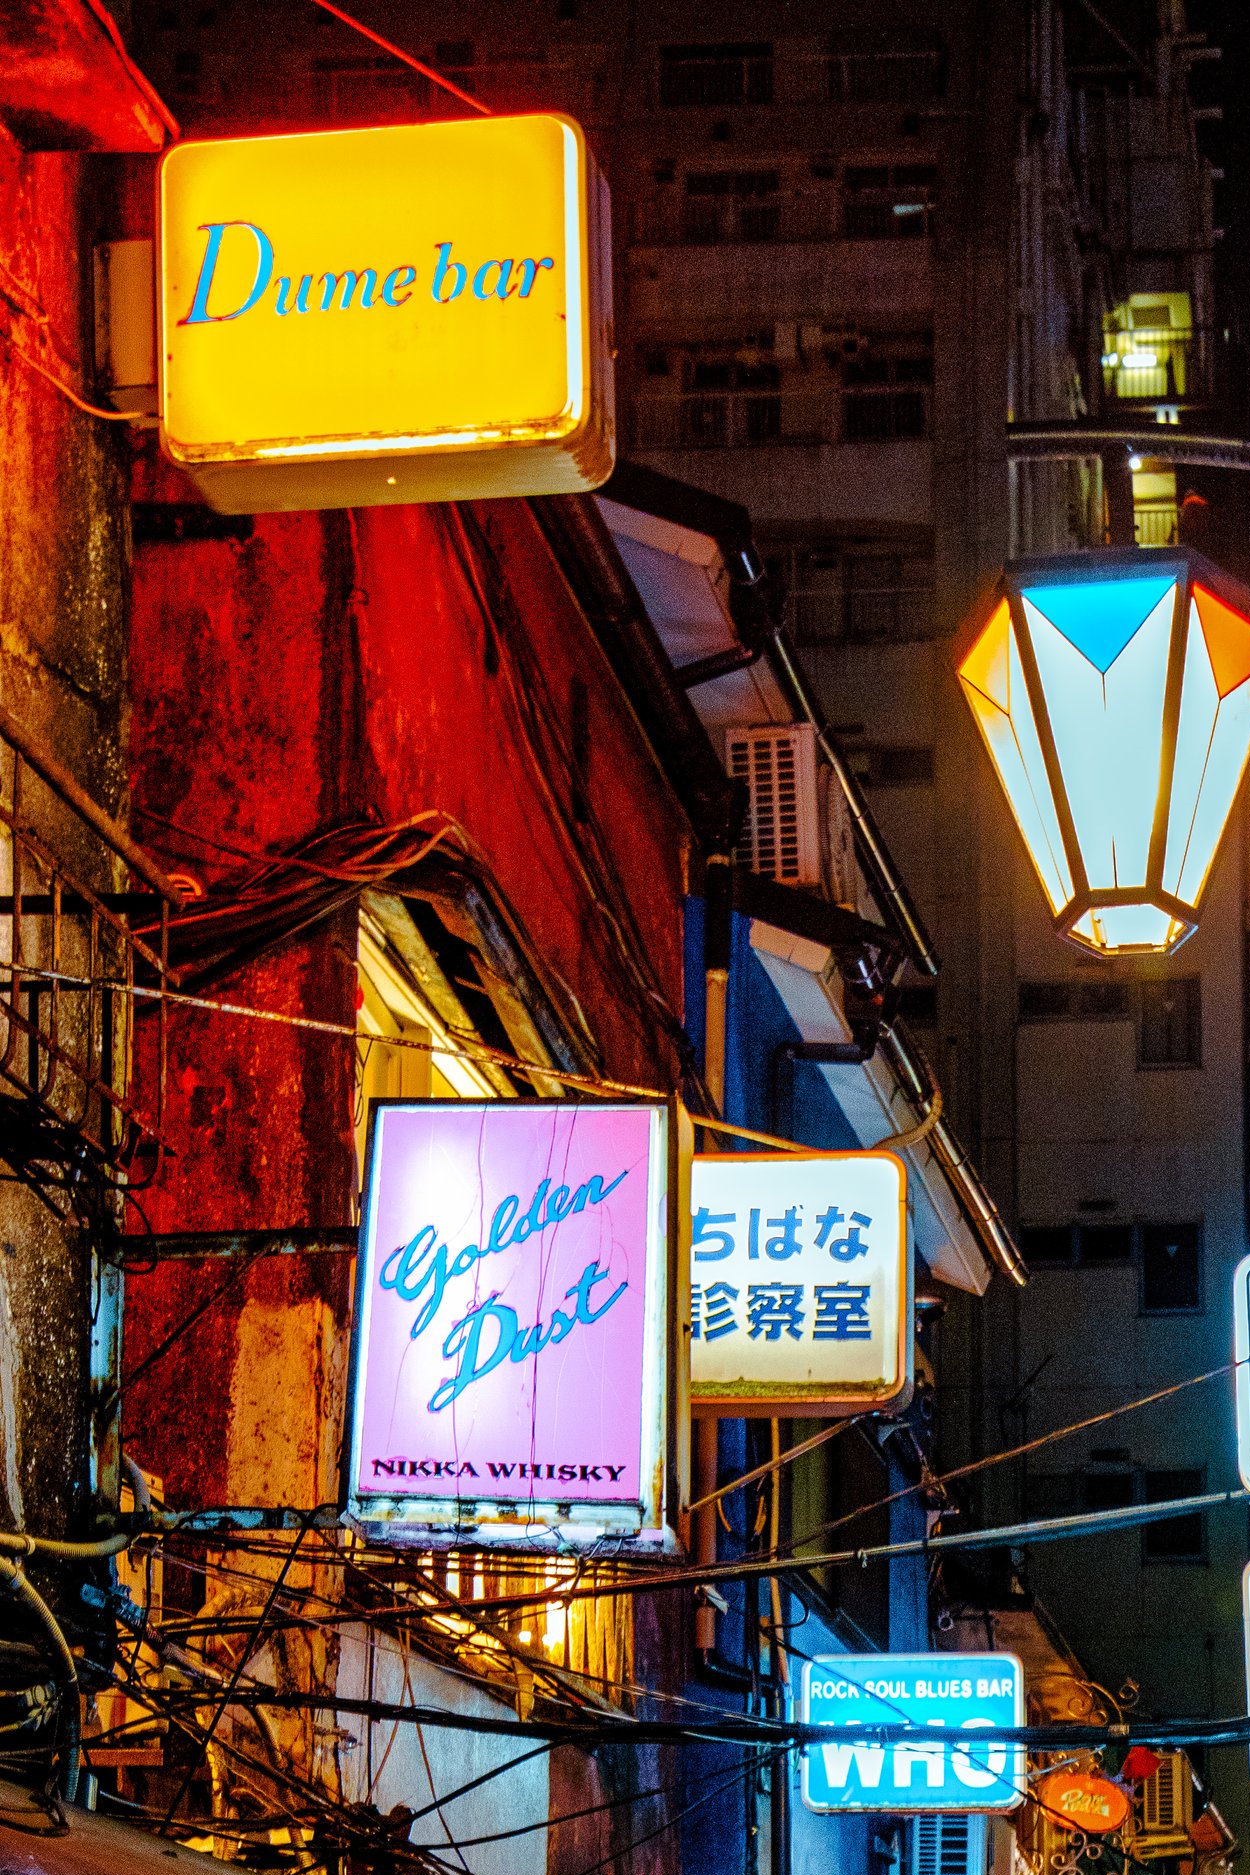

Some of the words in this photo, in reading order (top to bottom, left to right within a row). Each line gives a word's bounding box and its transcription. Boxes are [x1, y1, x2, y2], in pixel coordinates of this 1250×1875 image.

[178, 221, 416, 327] Dume
[431, 241, 555, 307] bar
[380, 1169, 629, 1338] Golden
[690, 1203, 874, 1263] ちばな
[428, 1260, 628, 1413] Dust
[690, 1280, 874, 1342] 診察室
[371, 1458, 479, 1480] NIKKA
[487, 1460, 628, 1484] WHISKY
[810, 1679, 861, 1700] ROCK
[864, 1679, 912, 1699] SOUL
[915, 1679, 973, 1699] BLUES
[976, 1678, 1014, 1698] BAR
[815, 1716, 1008, 1789] WHO
